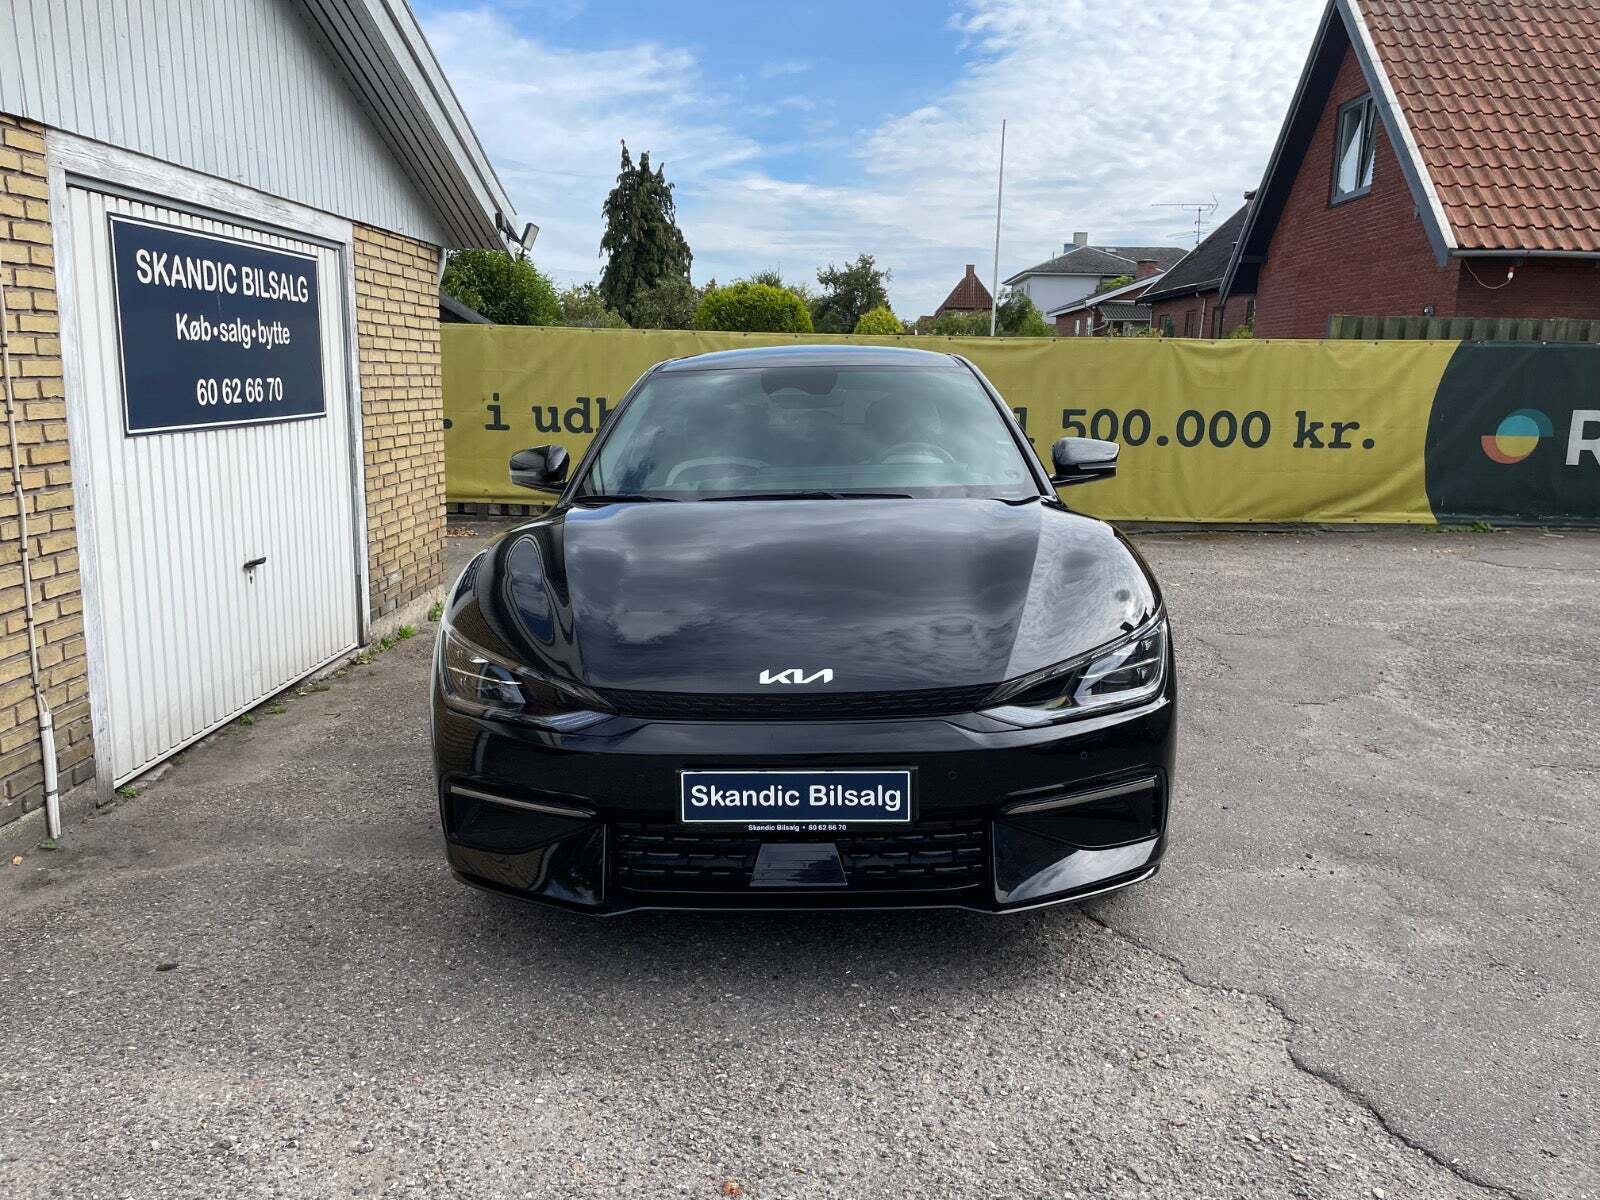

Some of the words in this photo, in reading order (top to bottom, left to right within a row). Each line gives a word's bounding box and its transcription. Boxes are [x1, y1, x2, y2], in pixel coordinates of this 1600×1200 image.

[136, 249, 237, 294] SKANDIC
[242, 266, 309, 303] BILSALG
[196, 379, 218, 406] 60
[222, 378, 242, 404] 62
[245, 378, 264, 403] 66
[266, 377, 283, 401] 70
[484, 392, 510, 431] i
[1062, 408, 1271, 449] 500.000
[1292, 411, 1375, 449] kr.
[759, 668, 834, 685] KIA
[691, 785, 800, 807] Skandic
[809, 785, 901, 811] Bilsalg
